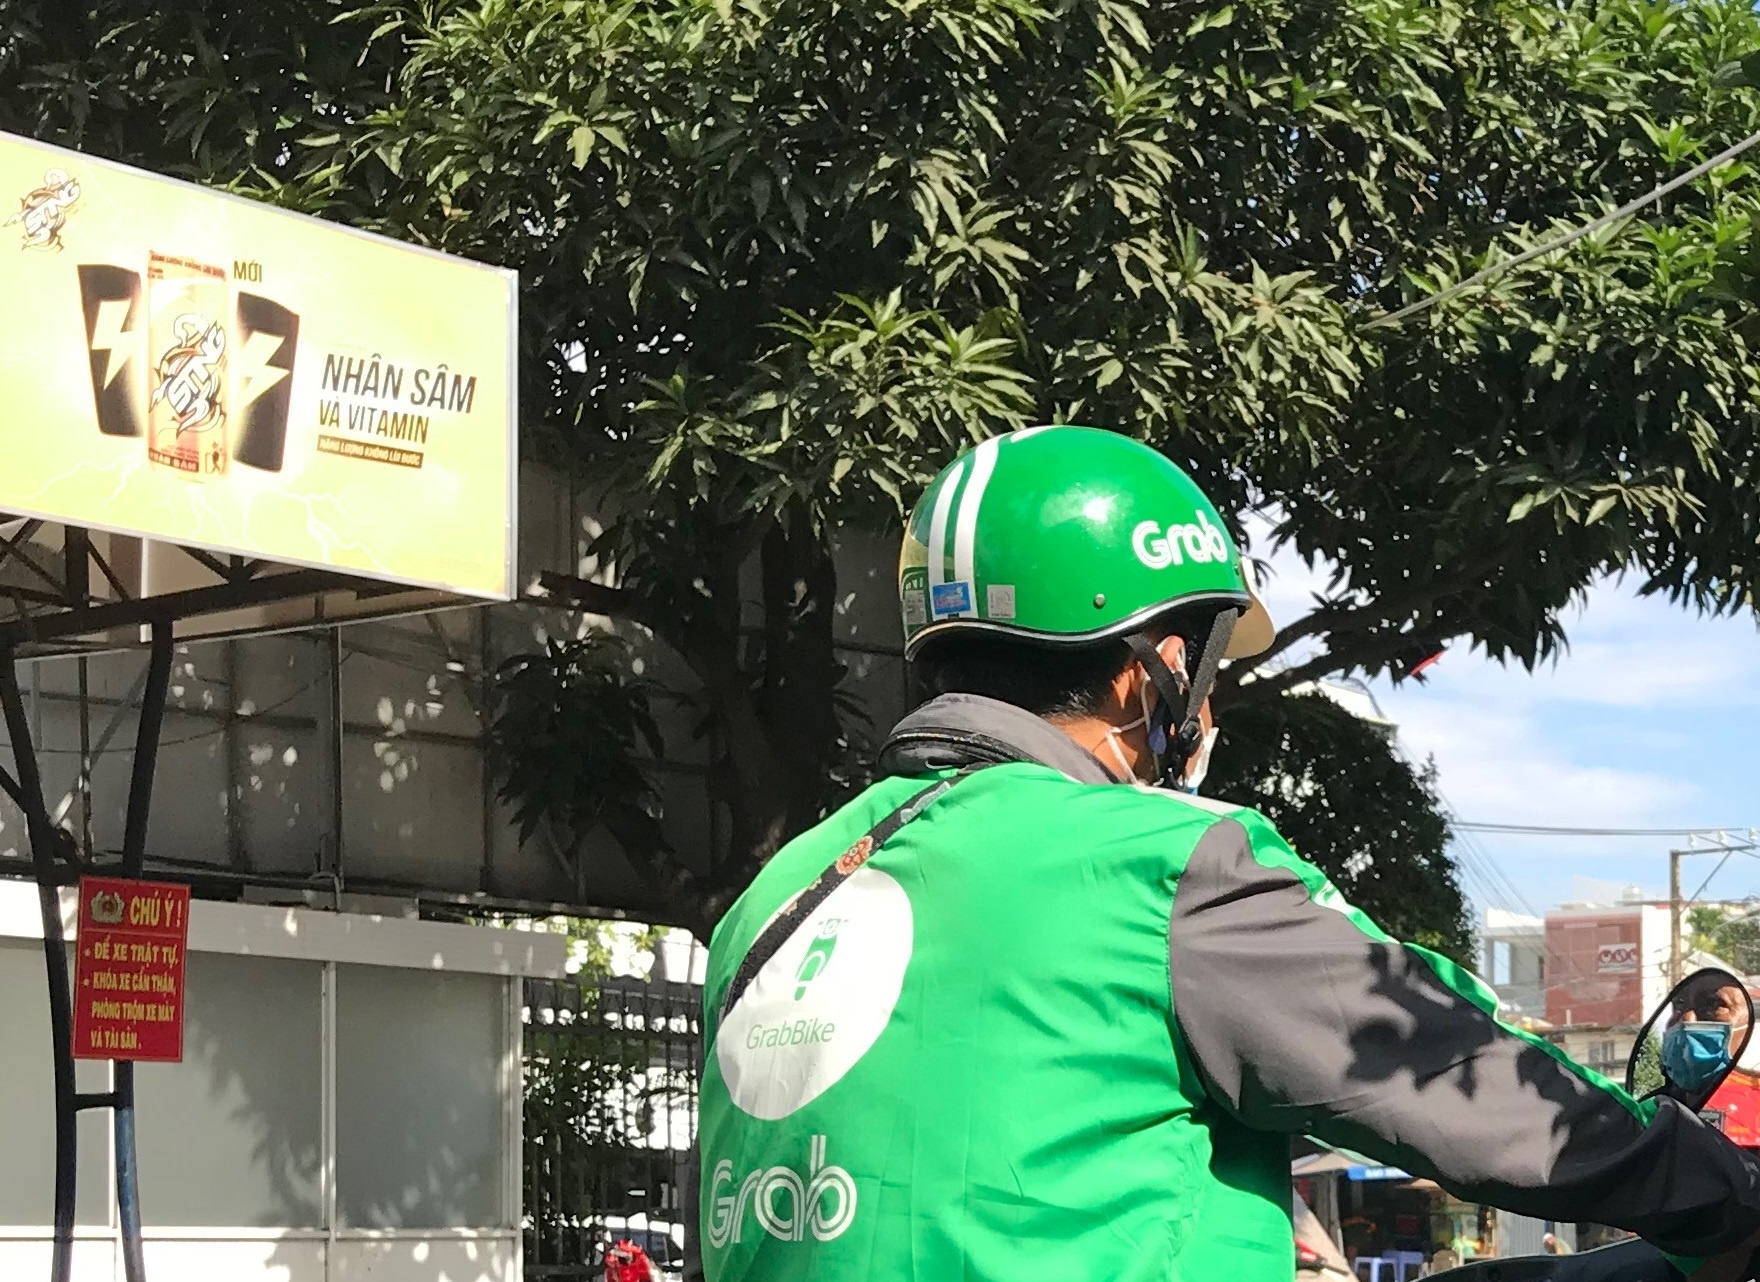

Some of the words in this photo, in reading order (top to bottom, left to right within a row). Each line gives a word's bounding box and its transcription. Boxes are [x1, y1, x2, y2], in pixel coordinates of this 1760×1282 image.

[233, 258, 263, 283] MỚI
[322, 353, 403, 400] NHÂN
[410, 363, 477, 414] SÂM
[320, 395, 340, 428] VÀ
[349, 404, 429, 444] VITAMIN
[1132, 509, 1228, 570] Grab
[130, 890, 161, 927] CHÚ
[94, 934, 111, 960] ĐỂ
[112, 943, 127, 961] XE
[131, 941, 159, 968] TRẬT
[93, 967, 117, 990] KHÓA
[119, 972, 131, 991] XE
[145, 1004, 157, 1021] XE
[91, 1026, 102, 1048] VÀ
[104, 1026, 118, 1048] TÀI
[746, 1017, 836, 1049] GrabBike
[708, 1135, 857, 1248] Grab
